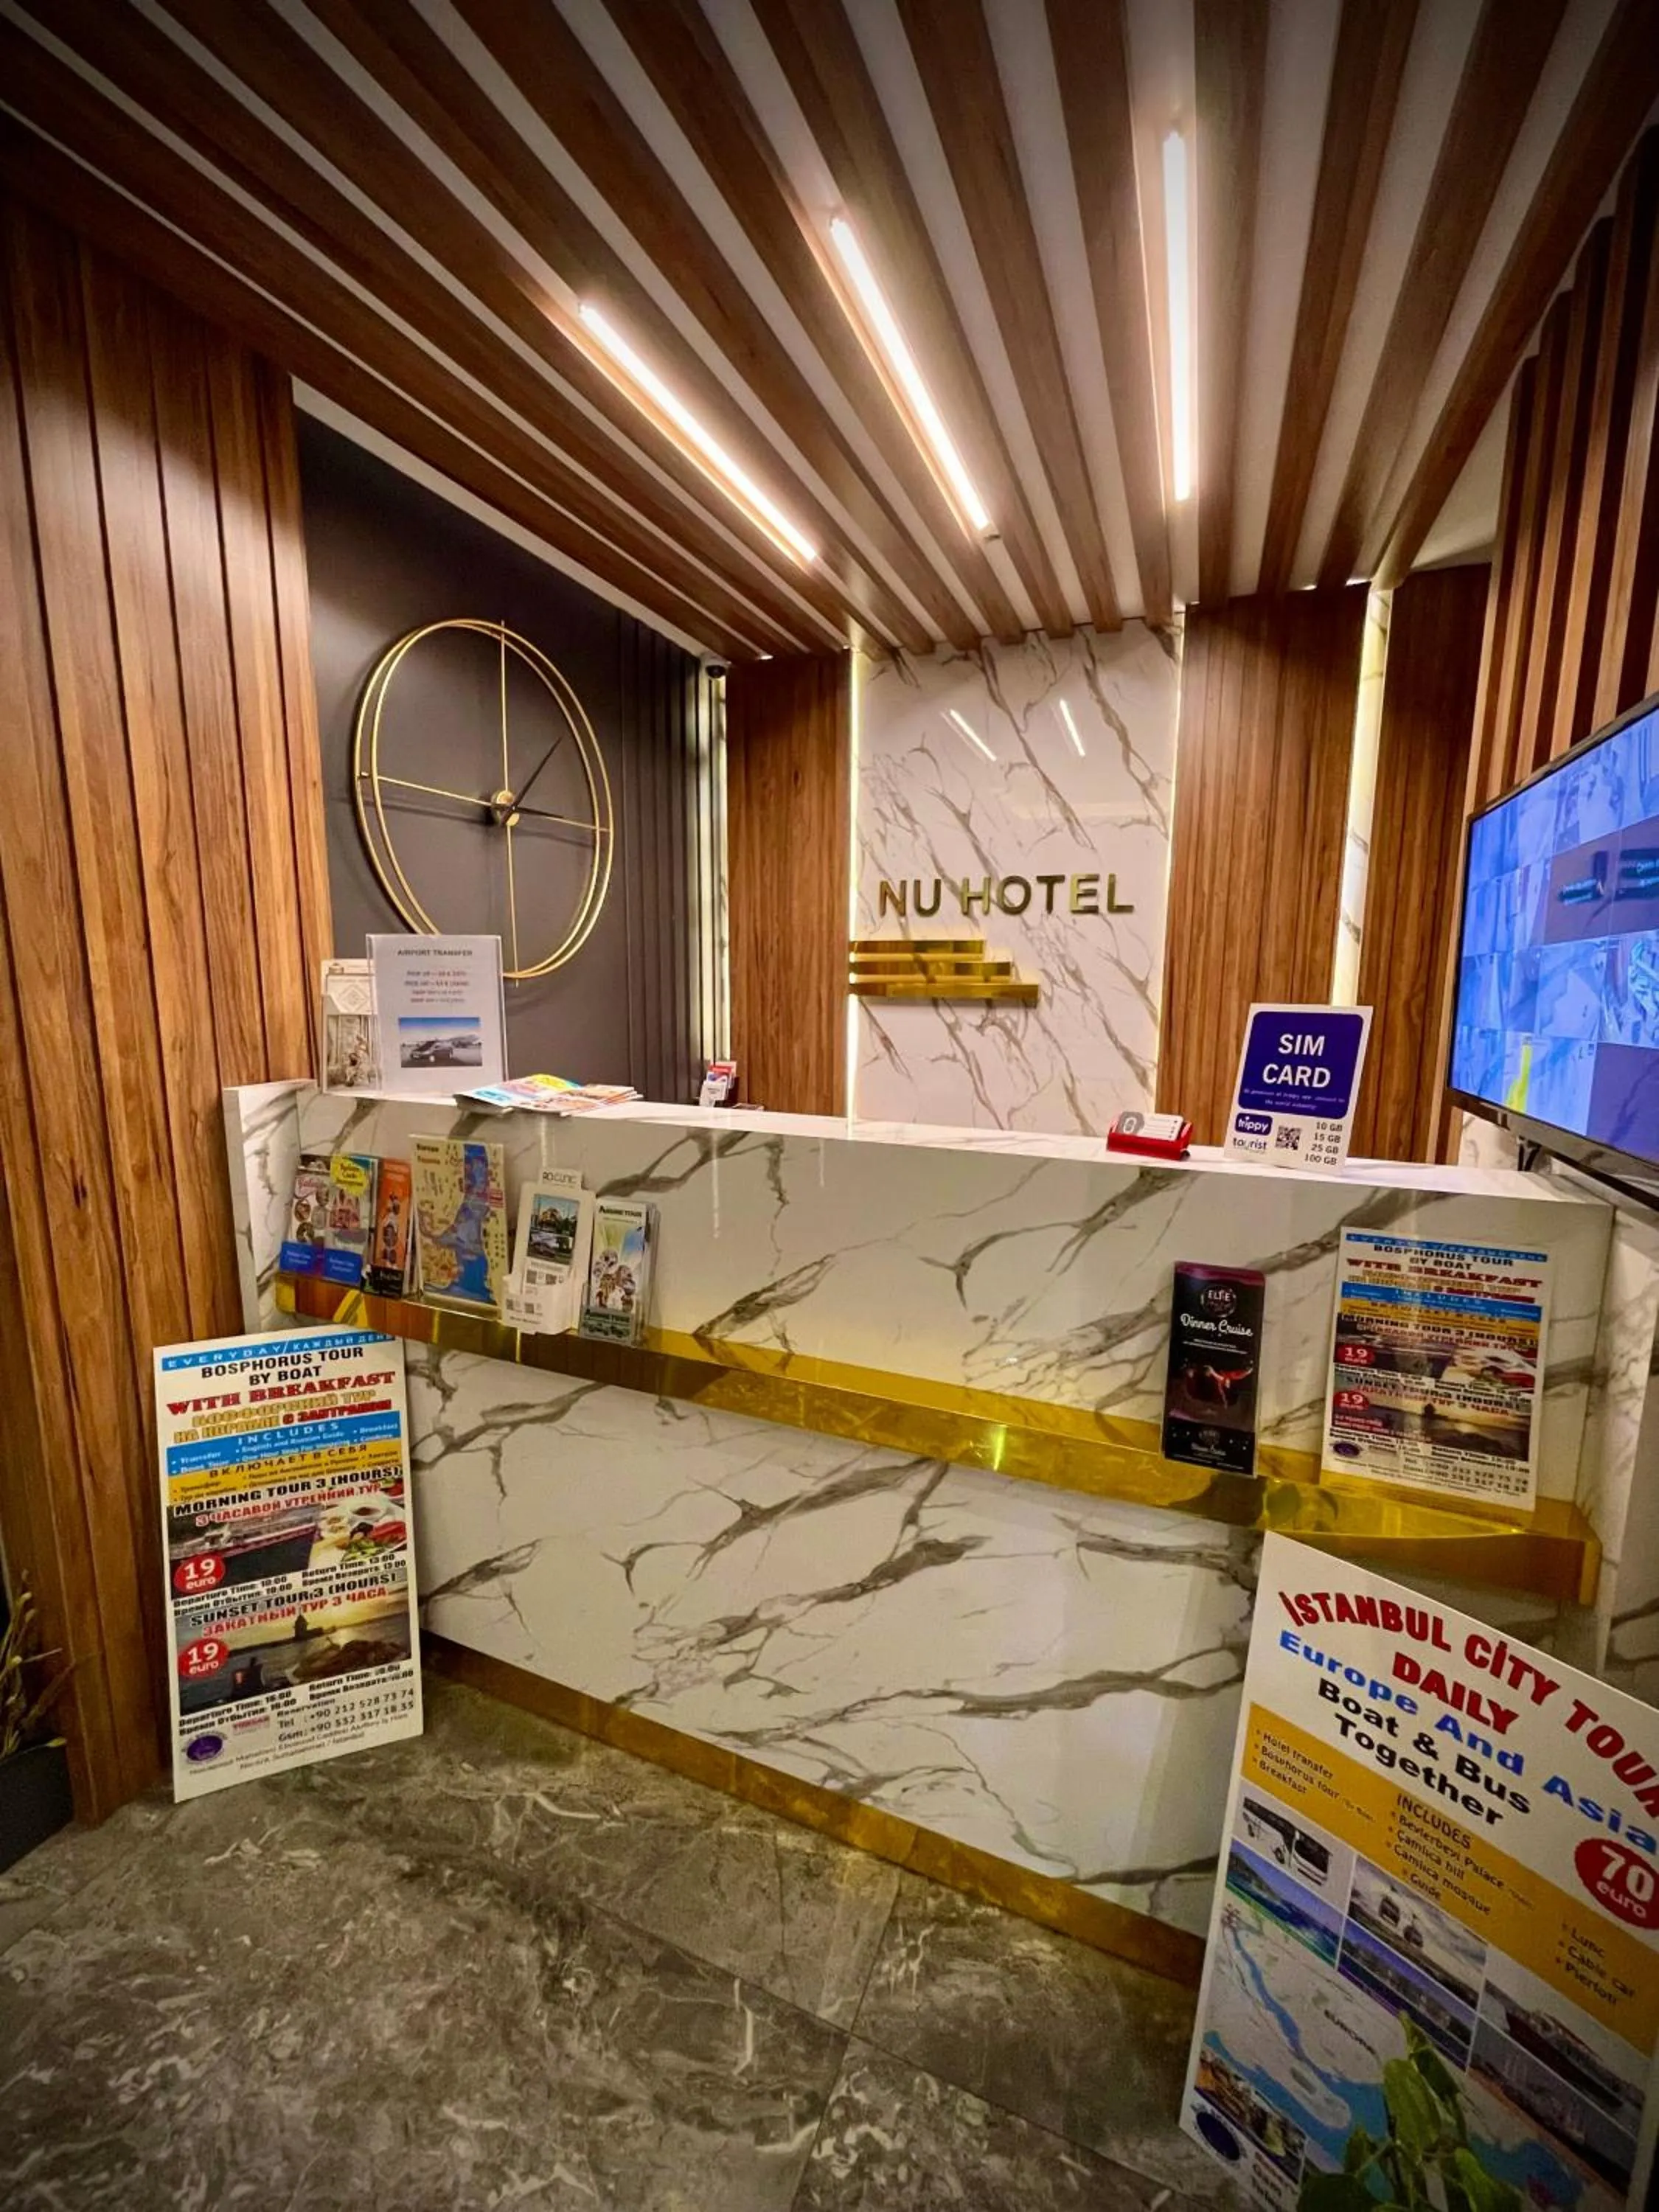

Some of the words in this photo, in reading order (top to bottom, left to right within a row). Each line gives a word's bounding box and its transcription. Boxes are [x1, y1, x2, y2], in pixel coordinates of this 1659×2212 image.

[879, 877, 942, 917] NU
[961, 873, 1135, 916] HOTEL
[1278, 1034, 1325, 1057] SIM
[1262, 1063, 1331, 1088] CARD
[1238, 1116, 1269, 1133] trippy
[1316, 1121, 1327, 1130] 10
[1329, 1123, 1343, 1132] GB
[1233, 1138, 1267, 1150] torist
[1311, 1144, 1324, 1152] 25
[1325, 1146, 1338, 1154] GB
[1328, 1134, 1340, 1143] GB
[1304, 1154, 1321, 1164] 100
[1324, 1157, 1337, 1165] GB
[1347, 1258, 1401, 1271] WITH
[1408, 1266, 1543, 1288] BREAKFAST
[1433, 1259, 1472, 1270] BOAT
[1472, 1256, 1514, 1267] TOUR
[1180, 1313, 1217, 1330] Dinner
[1218, 1319, 1253, 1336] Cruise
[201, 1352, 313, 1379] BOSPHORUS
[319, 1346, 364, 1362] TOUR
[1344, 1346, 1368, 1357] 19
[249, 1372, 271, 1386] BY
[278, 1365, 321, 1382] BOAT
[167, 1391, 240, 1416] WITH
[249, 1371, 395, 1402] BREAKFAST
[1340, 1392, 1364, 1404] 19
[237, 1422, 339, 1446] INCLUDES
[209, 1454, 308, 1478] ВКЛЮЧАЕТ
[327, 1444, 367, 1456] СЕБЯ
[175, 1489, 262, 1517] MORNING
[267, 1481, 311, 1498] TOUR
[316, 1478, 326, 1489] 3
[358, 1483, 381, 1495] ТУР
[184, 1559, 216, 1580] 19
[302, 1566, 337, 1579] Return
[186, 1576, 216, 1590] euro
[173, 1589, 228, 1608] Departure
[189, 1601, 258, 1627] SUNSET
[265, 1590, 309, 1609] TOUR
[313, 1587, 324, 1598] 3
[301, 1599, 328, 1613] ТУР
[333, 1596, 342, 1606] 3
[346, 1587, 387, 1603] ЧАСА
[187, 1642, 219, 1665] 19
[189, 1660, 219, 1674] euro
[309, 1677, 344, 1692] Return
[1391, 1652, 1520, 1735] DAILY
[278, 1718, 295, 1729] Tel
[1278, 1630, 1419, 1716] Europe
[1434, 1713, 1525, 1776] And
[1542, 1774, 1658, 1856] Asia
[1317, 1677, 1399, 1736] Boat
[1412, 1731, 1440, 1761] &
[1455, 1753, 1531, 1815] Bus
[1262, 1745, 1315, 1785] Bosphorus
[1263, 1733, 1290, 1754] Hotel
[1292, 1749, 1334, 1780] transfer
[1259, 1759, 1307, 1794] Breakfast
[1334, 1713, 1504, 1826] Together
[1397, 1792, 1472, 1850] INCLUDES
[1600, 1844, 1655, 1903] 70
[1596, 1879, 1647, 1919] euro
